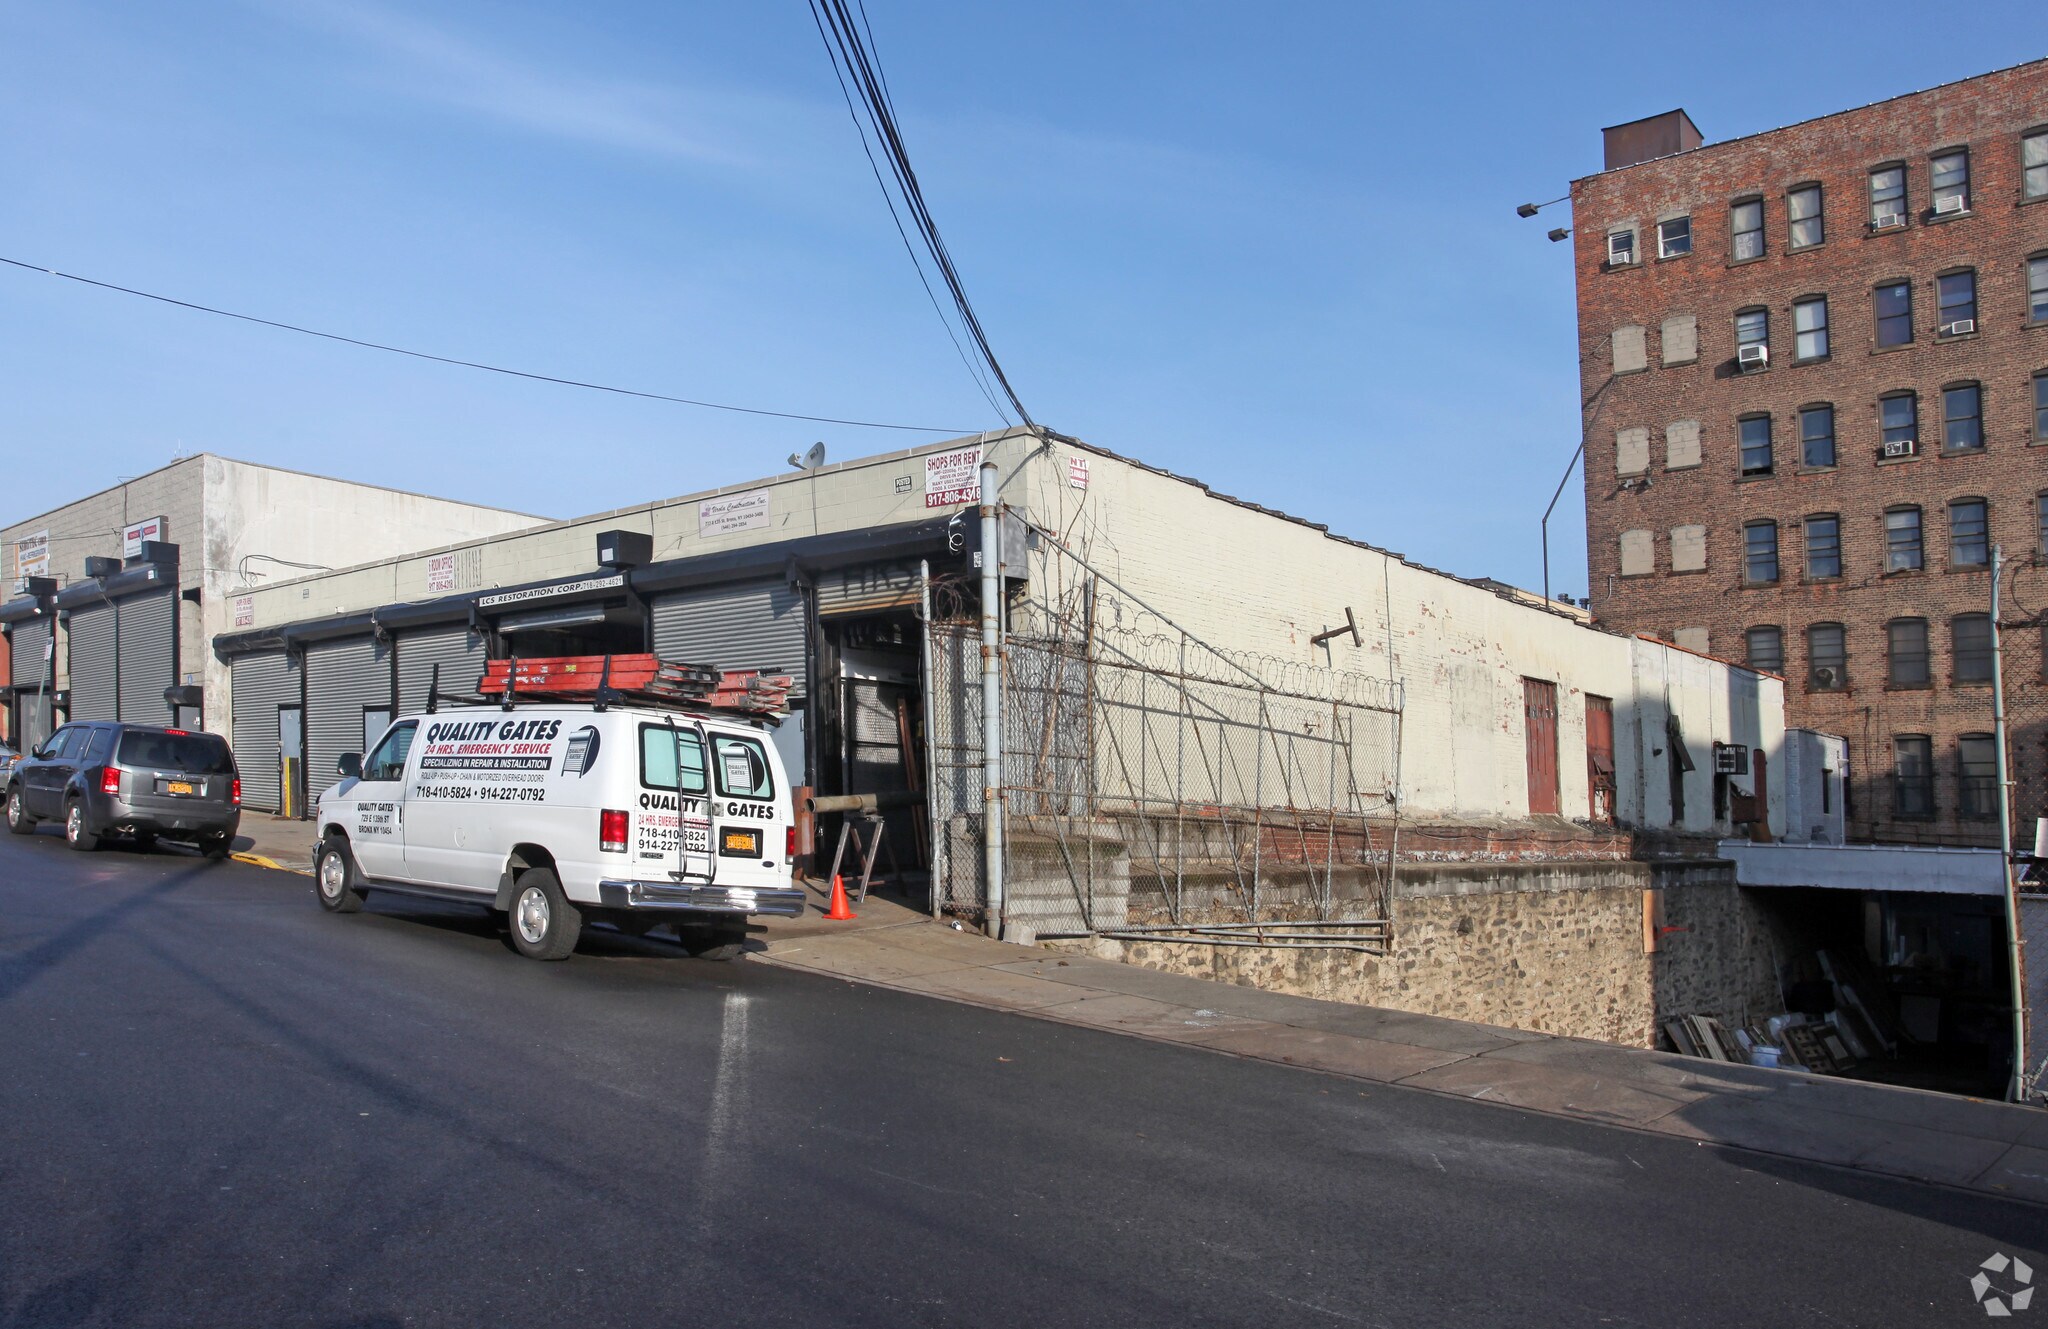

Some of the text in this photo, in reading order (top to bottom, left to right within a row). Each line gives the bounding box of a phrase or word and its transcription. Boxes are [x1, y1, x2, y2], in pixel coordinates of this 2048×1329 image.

[927, 450, 981, 471] SHOPS FOR RENT
[928, 486, 981, 506] 917-806-4318
[498, 587, 554, 603] RESTORATION
[557, 583, 583, 593] CORP.
[426, 719, 562, 744] QUALITY GATES
[424, 743, 552, 755] 24 HRS. EMERGENCY SERVICE
[423, 758, 548, 769] SPECIALIZING IN REPAIR & INSTALLATION
[459, 772, 472, 780] CHAIN
[477, 773, 501, 781] MOTORIZED
[502, 773, 526, 782] OVERHEAD
[527, 774, 545, 782] DOORS
[416, 786, 545, 801] 718-410-5824 914-227-0792
[357, 803, 394, 812] QUALITY GATES
[639, 793, 774, 819] QUALITY GATES
[645, 815, 657, 825] HRS.
[358, 825, 373, 833] BRONX
